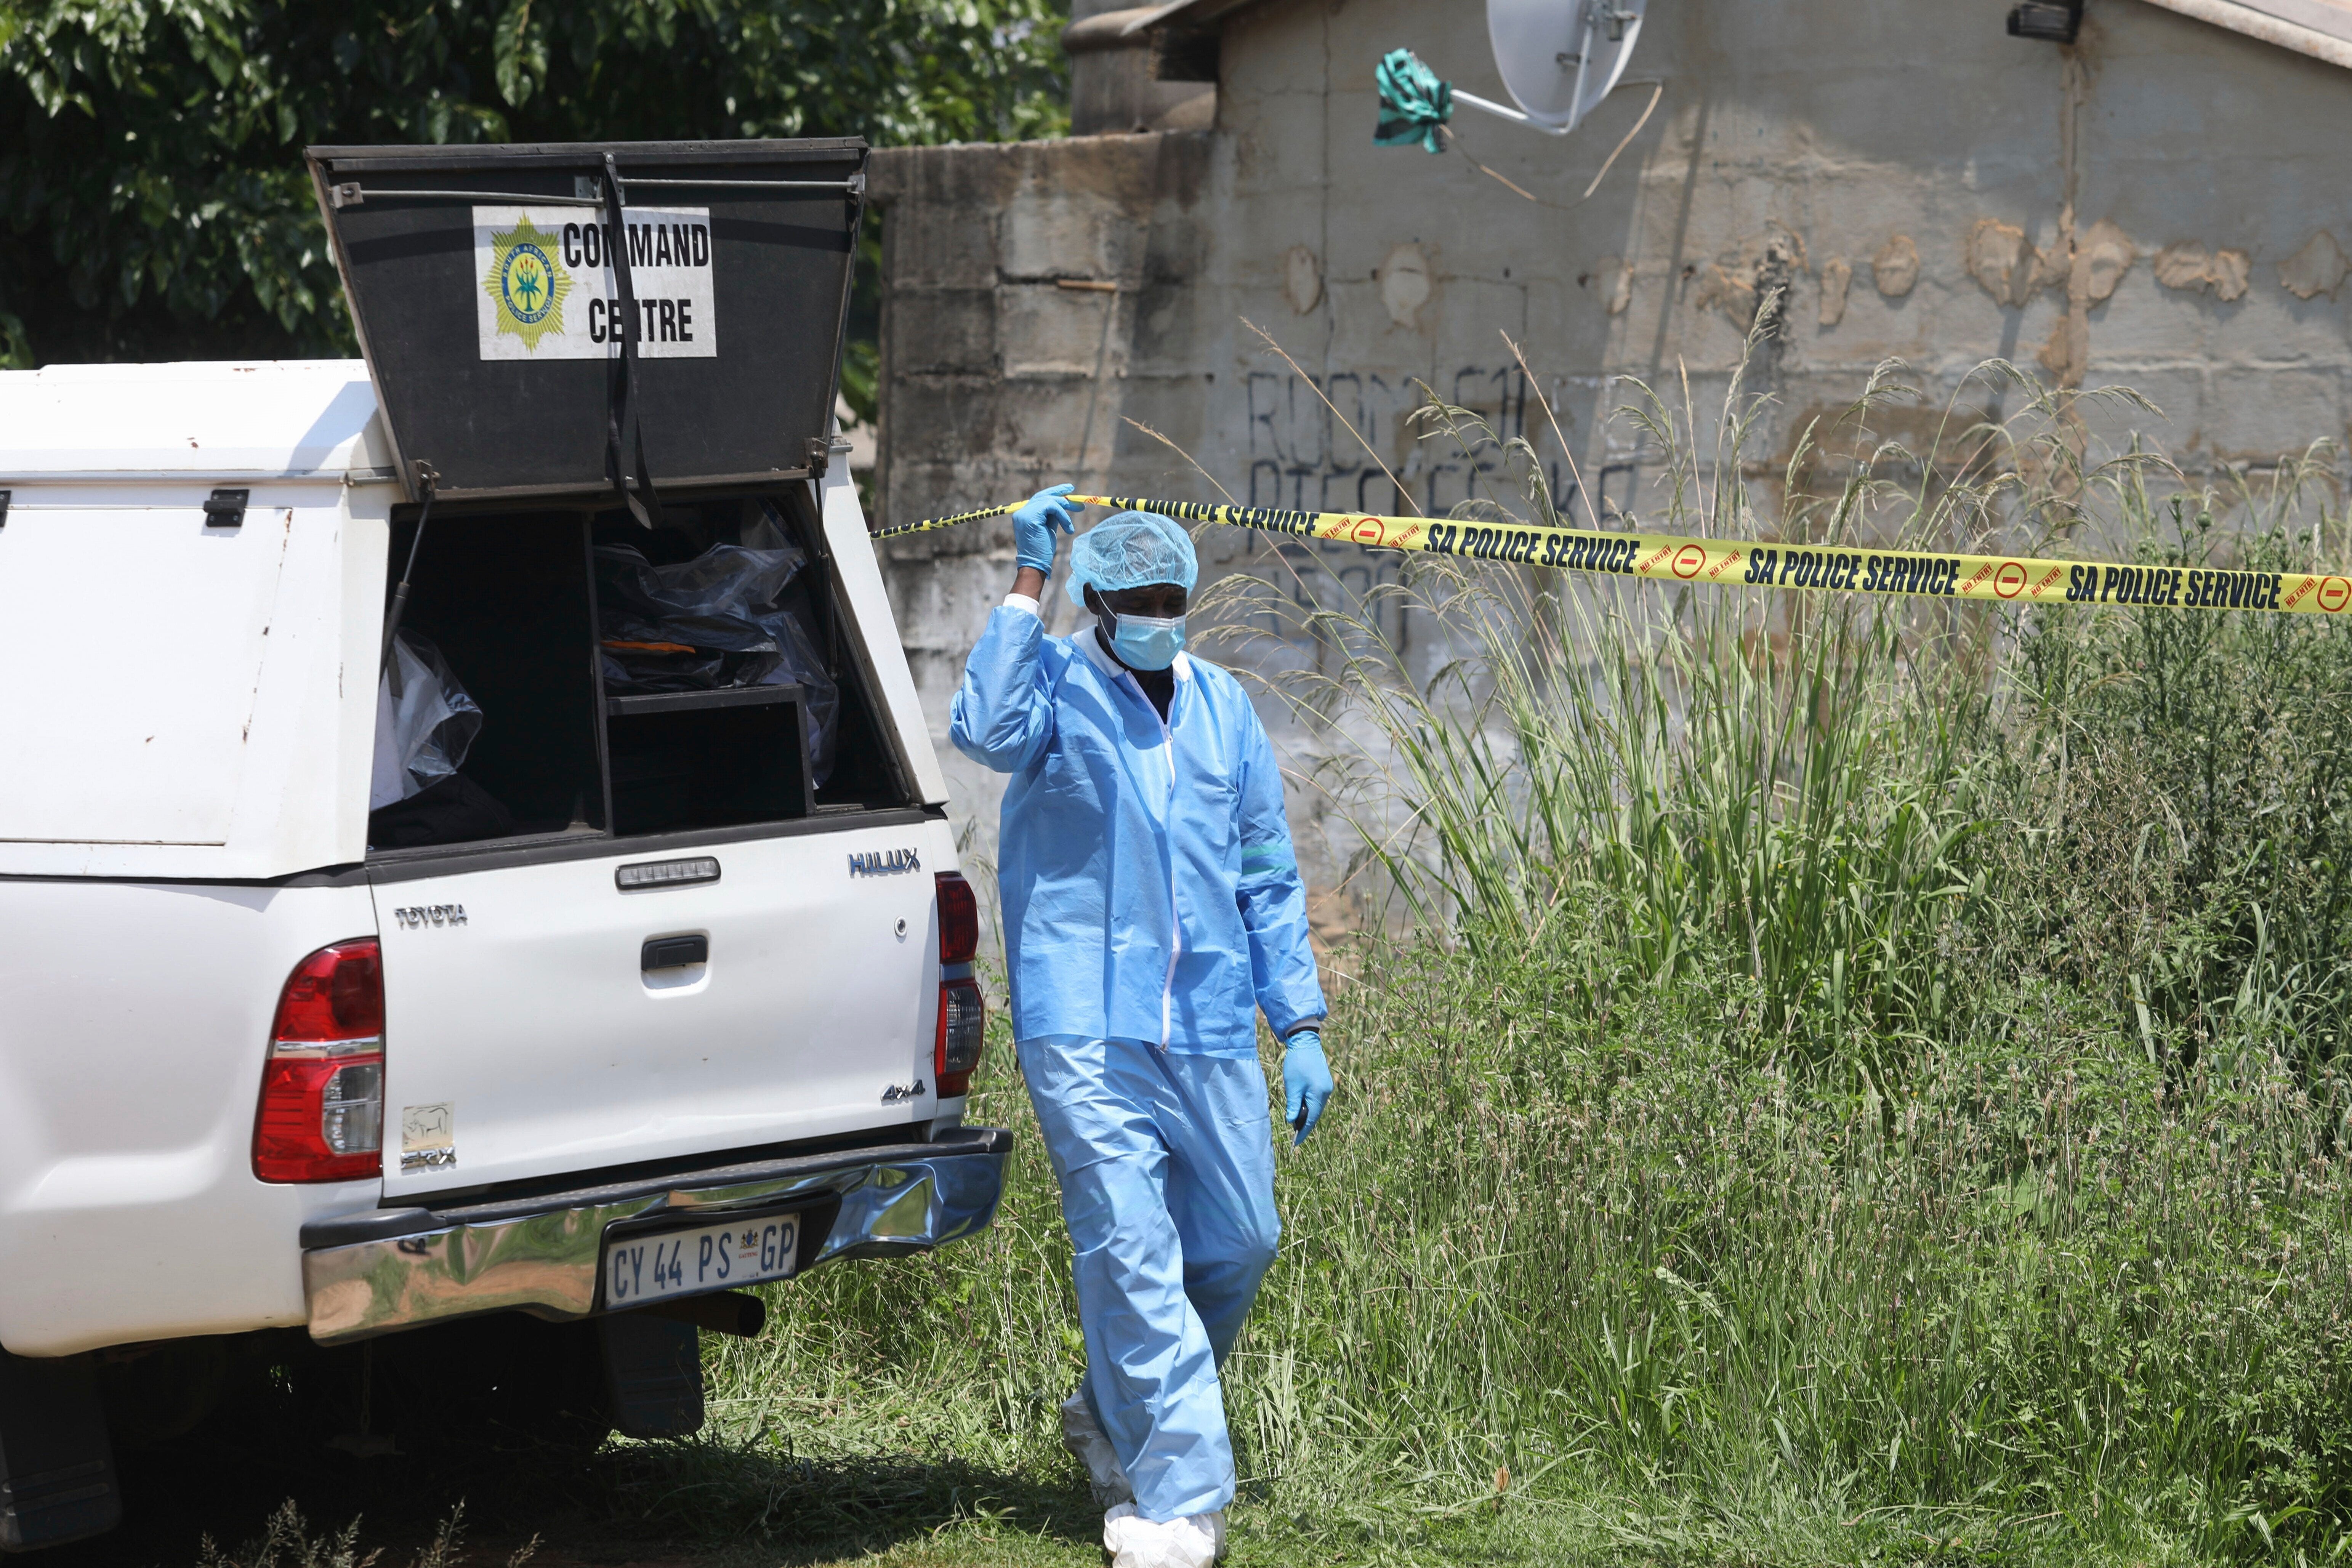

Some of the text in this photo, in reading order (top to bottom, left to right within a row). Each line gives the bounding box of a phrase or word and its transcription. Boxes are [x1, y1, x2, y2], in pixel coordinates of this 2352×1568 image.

[589, 298, 693, 343] CETRE
[1331, 517, 1351, 536] ENTRY
[1399, 525, 1420, 542] ENTRY
[1424, 524, 1640, 574] SA POLICE SERVICE
[1639, 546, 1672, 572] NO ENTRY
[1709, 551, 1741, 578] NO ENTRY
[1745, 548, 1961, 594] SA POLICE SERVICE
[1962, 564, 1993, 593] NO ENTRY
[2031, 567, 2062, 596] NO ENTRY
[2066, 564, 2283, 610] SA POLICE SERVICE
[2285, 577, 2315, 607] NO ENTRY
[847, 847, 921, 875] HILUX
[394, 903, 468, 927] TOYOTA
[614, 1222, 795, 1298] CY 44 PS GP
